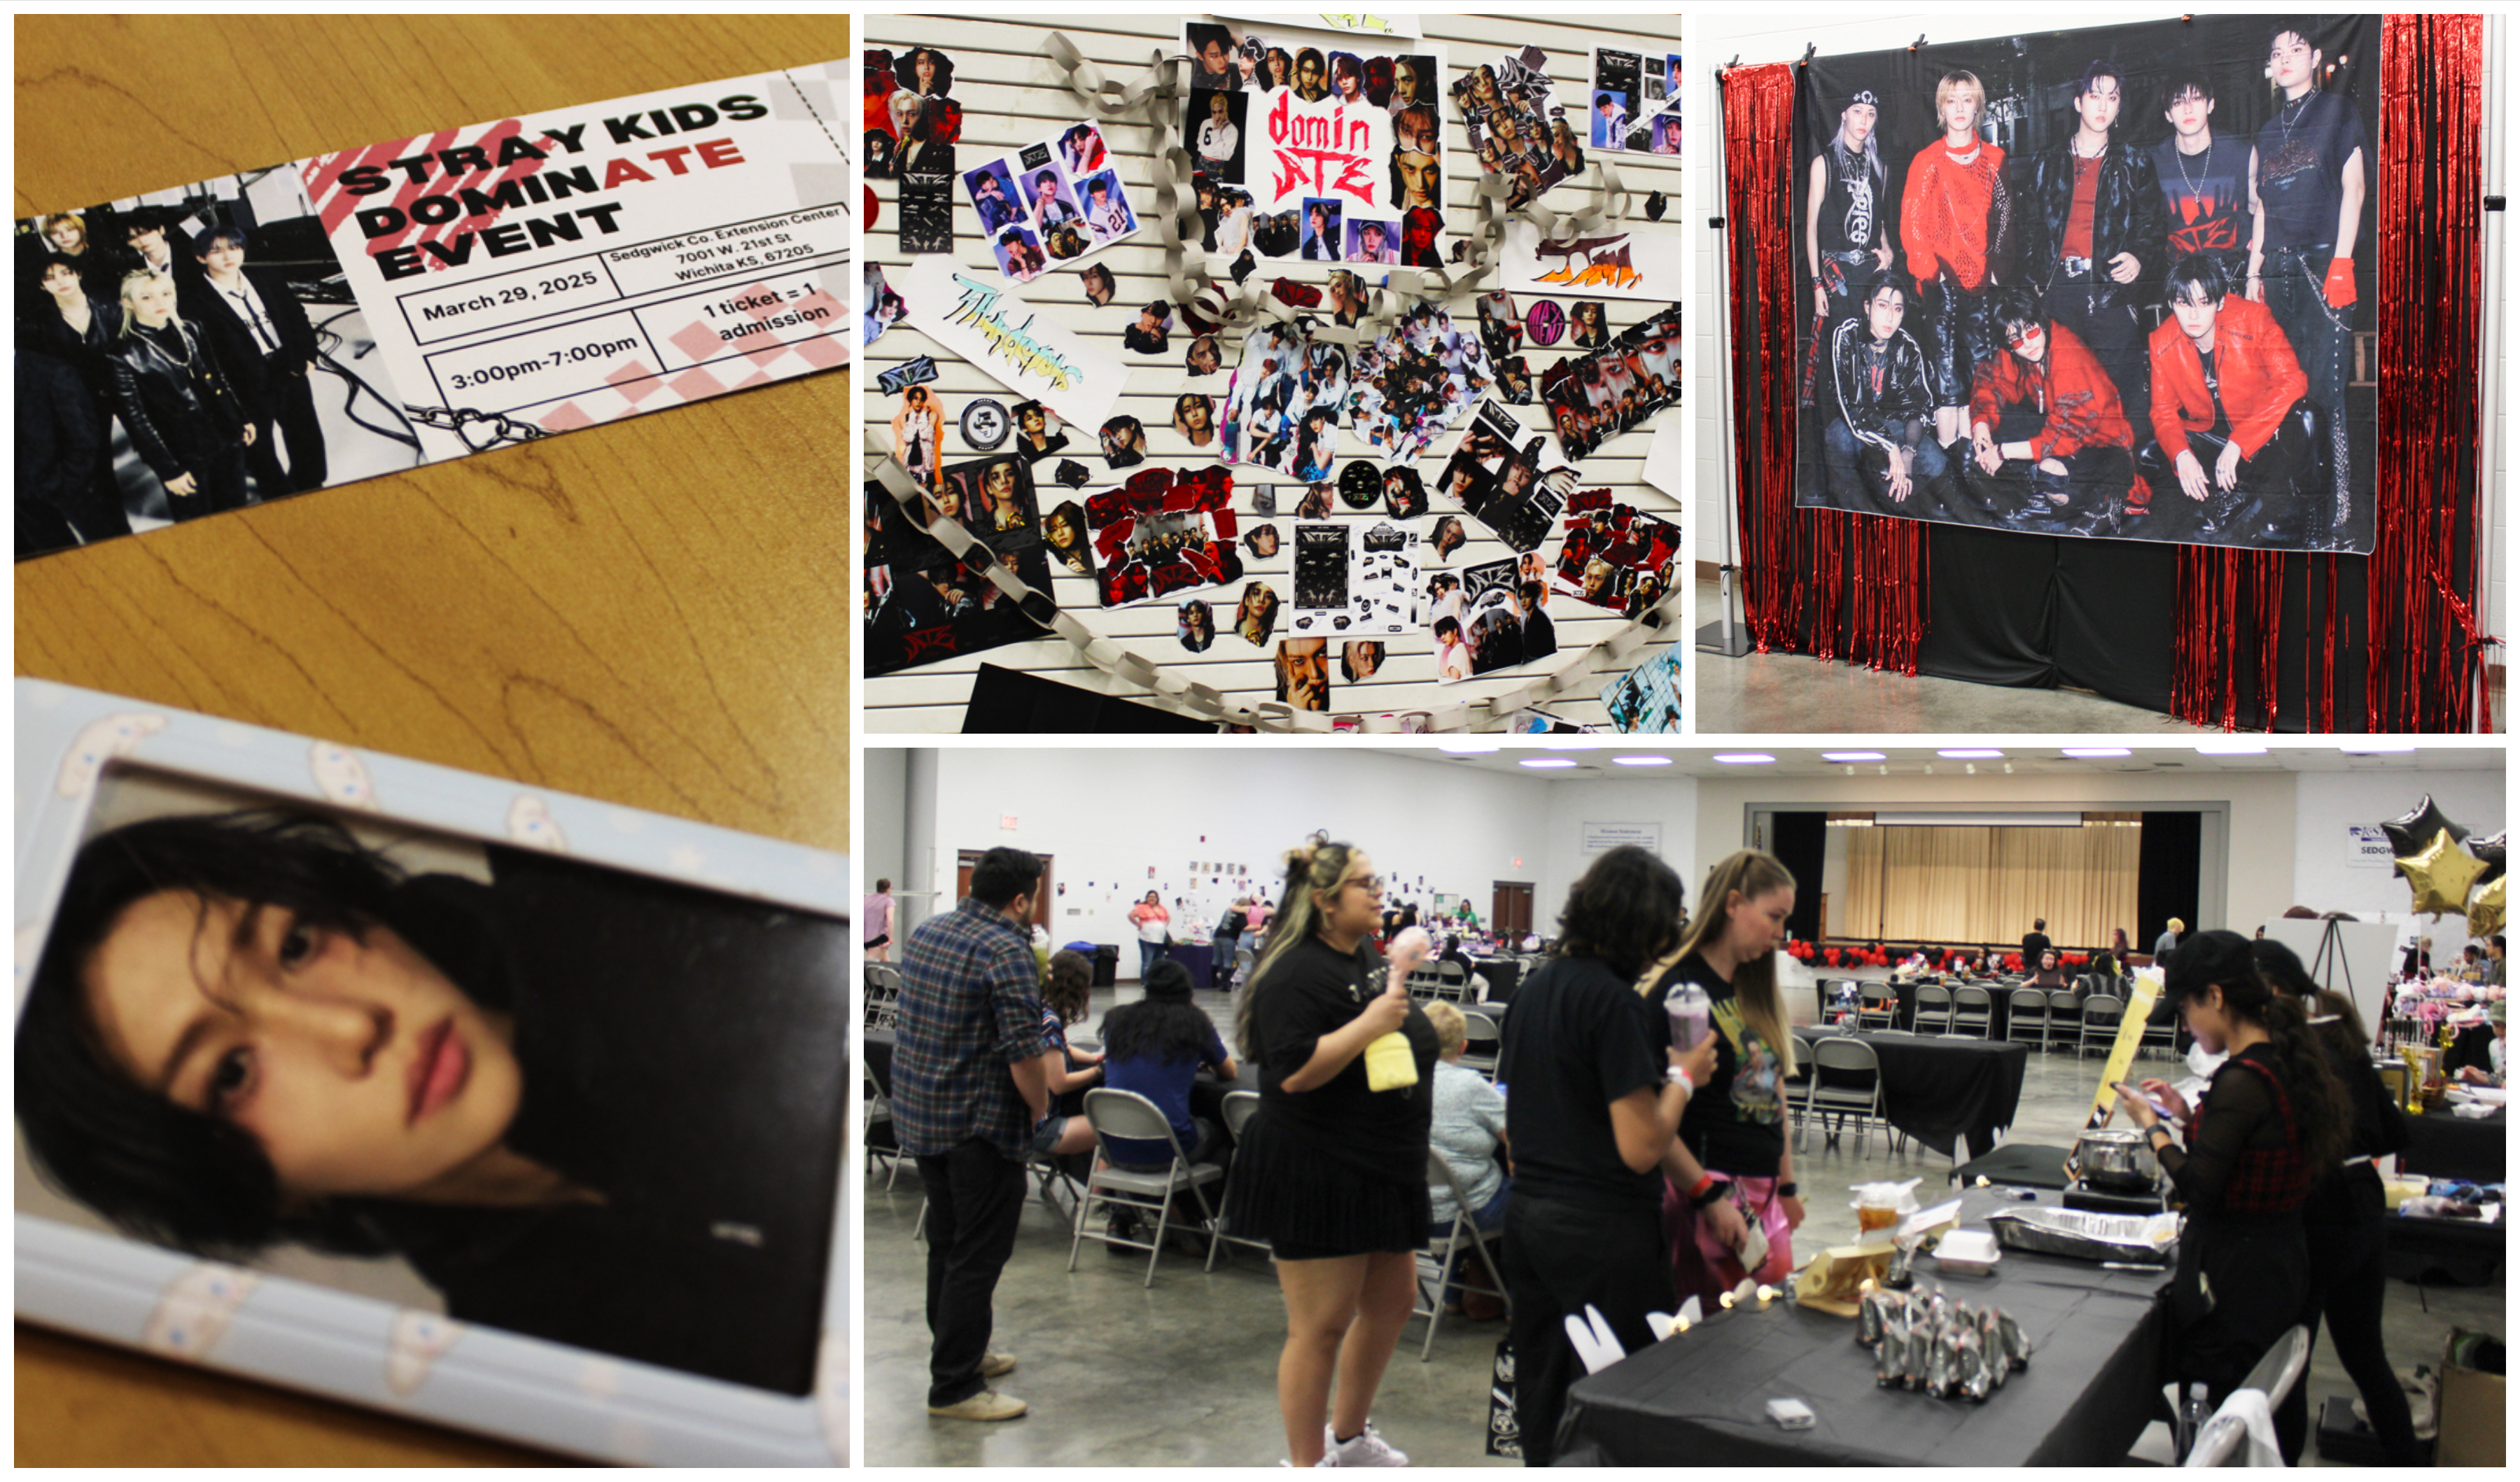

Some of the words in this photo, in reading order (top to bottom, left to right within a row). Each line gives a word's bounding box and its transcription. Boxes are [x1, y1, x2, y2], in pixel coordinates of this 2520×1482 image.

[337, 123, 587, 197] STRAY
[603, 95, 769, 143] KIDS
[1203, 127, 1212, 146] 6
[1268, 89, 1370, 152] domin
[354, 137, 746, 239] DOMINATE
[1272, 147, 1376, 209] ATE
[374, 202, 623, 281] EVENT
[610, 239, 685, 263] Sedgwick
[687, 233, 715, 245] Co.
[714, 217, 789, 240] Extension
[790, 208, 841, 225] Center
[1107, 209, 1126, 232] 21
[674, 258, 734, 281] Wichita
[736, 252, 764, 267] KS,
[764, 244, 814, 262] 67205
[675, 249, 715, 265] 7001
[717, 244, 739, 256] W.
[741, 237, 773, 251] 21st
[774, 232, 793, 244] St
[423, 295, 496, 321] March
[498, 286, 537, 304] 29,
[538, 271, 598, 295] 2025
[703, 305, 716, 318] 1
[718, 291, 783, 315] ticket
[786, 288, 800, 299] =
[803, 282, 817, 295] 1
[719, 305, 831, 342] admission
[451, 337, 638, 389] 3:00pm-7:00pm
